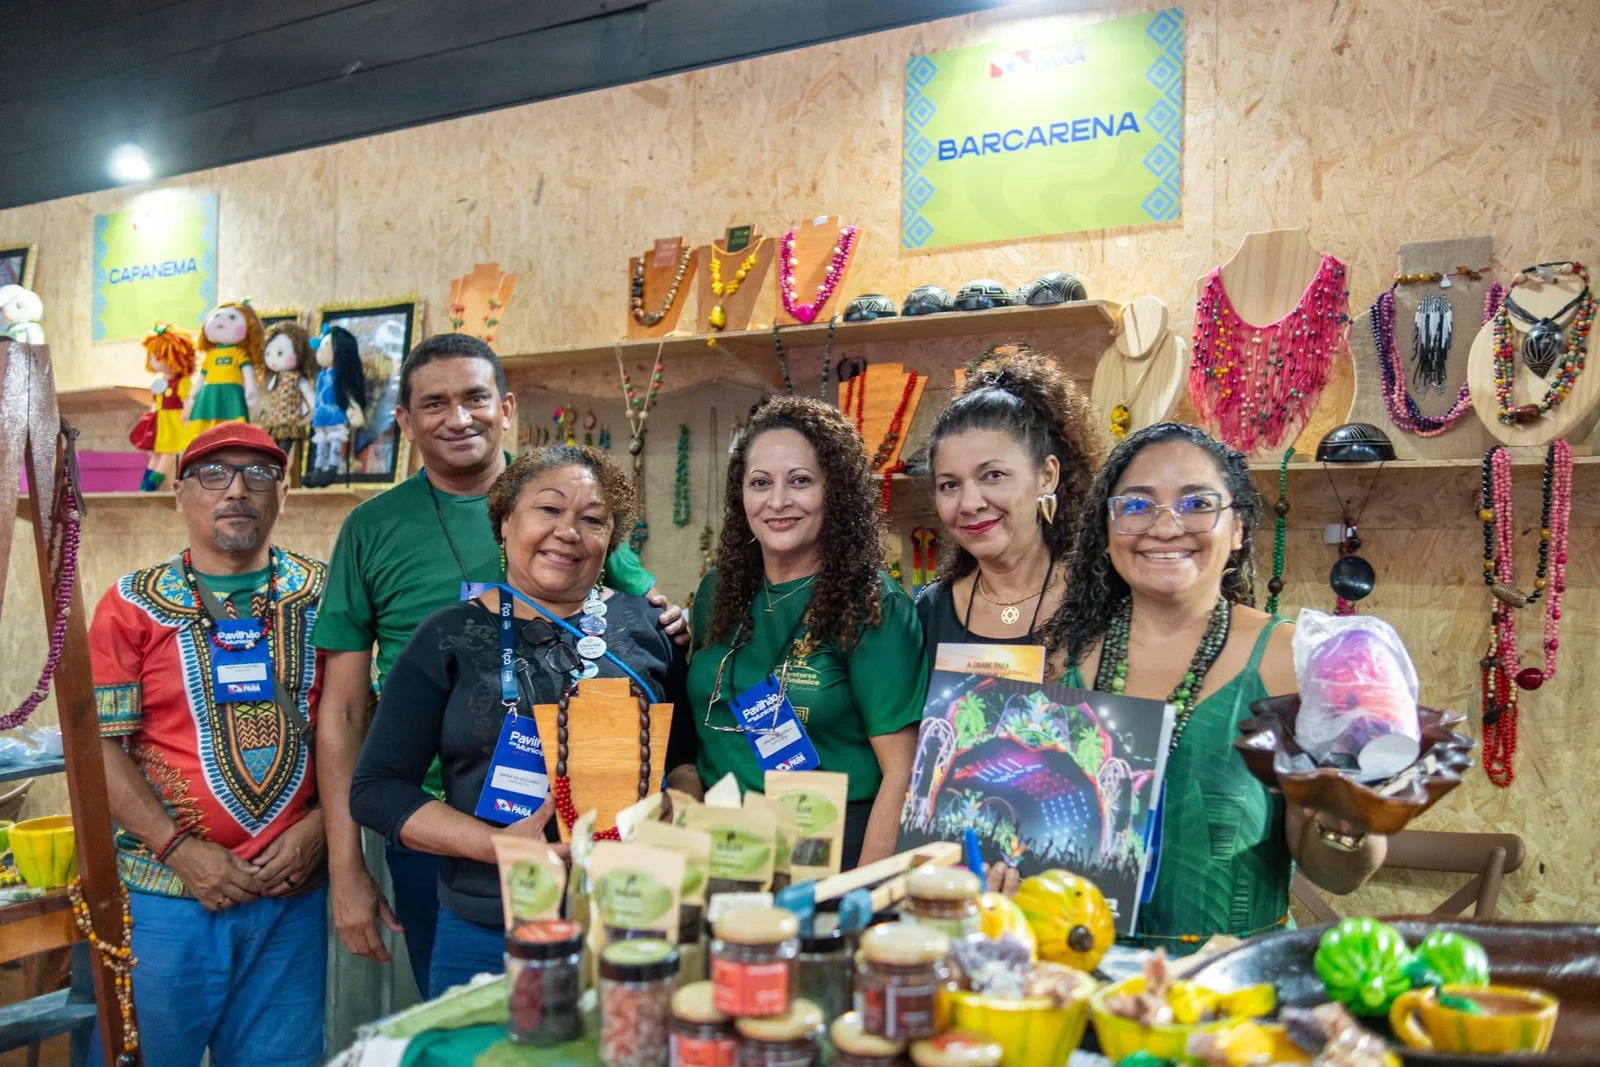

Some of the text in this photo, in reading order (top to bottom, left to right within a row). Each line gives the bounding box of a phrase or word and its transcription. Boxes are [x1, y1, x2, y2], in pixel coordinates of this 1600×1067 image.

[938, 111, 1141, 162] BARCARENA
[109, 257, 198, 285] CAPANEMA
[217, 630, 261, 641] Pavilhão
[742, 693, 778, 720] Pavilhão
